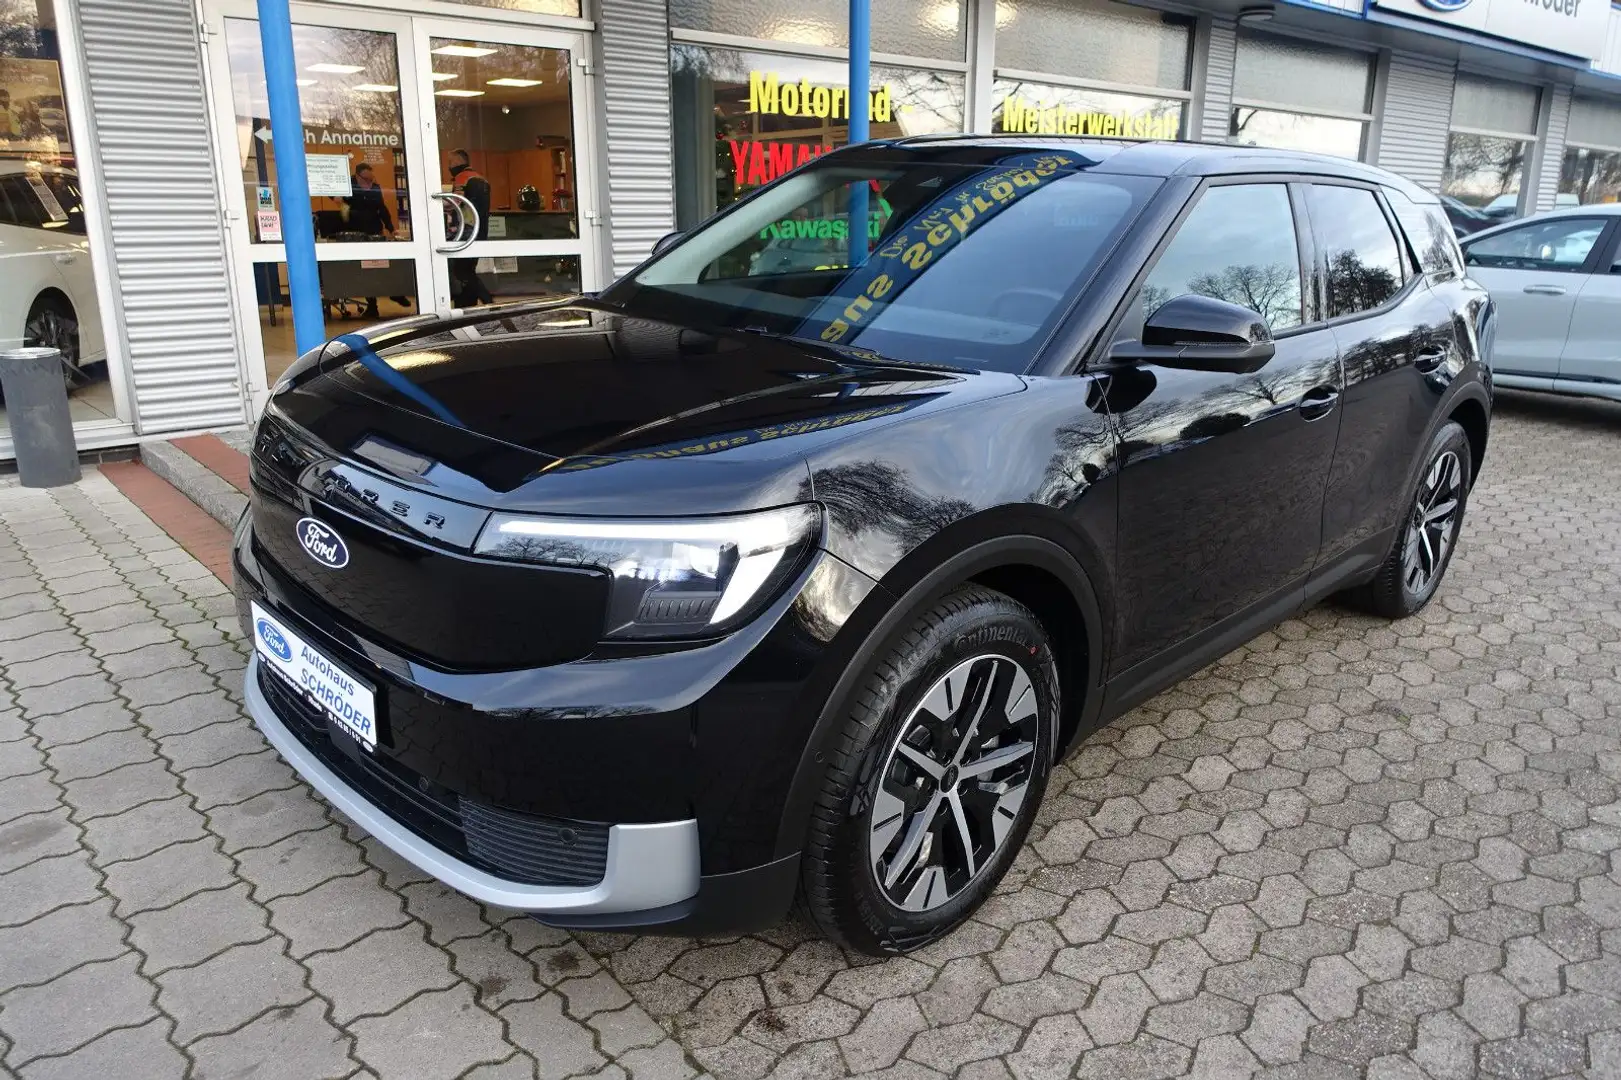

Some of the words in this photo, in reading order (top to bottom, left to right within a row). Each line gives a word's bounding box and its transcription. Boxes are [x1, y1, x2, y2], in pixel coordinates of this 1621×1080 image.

[320, 130, 399, 146] Annahme
[1003, 94, 1179, 141] Meisterwerkstatt
[304, 522, 337, 563] Ford
[264, 624, 285, 655] Ford
[301, 645, 354, 697] Autohaus
[301, 668, 371, 736] SCHRÖDER
